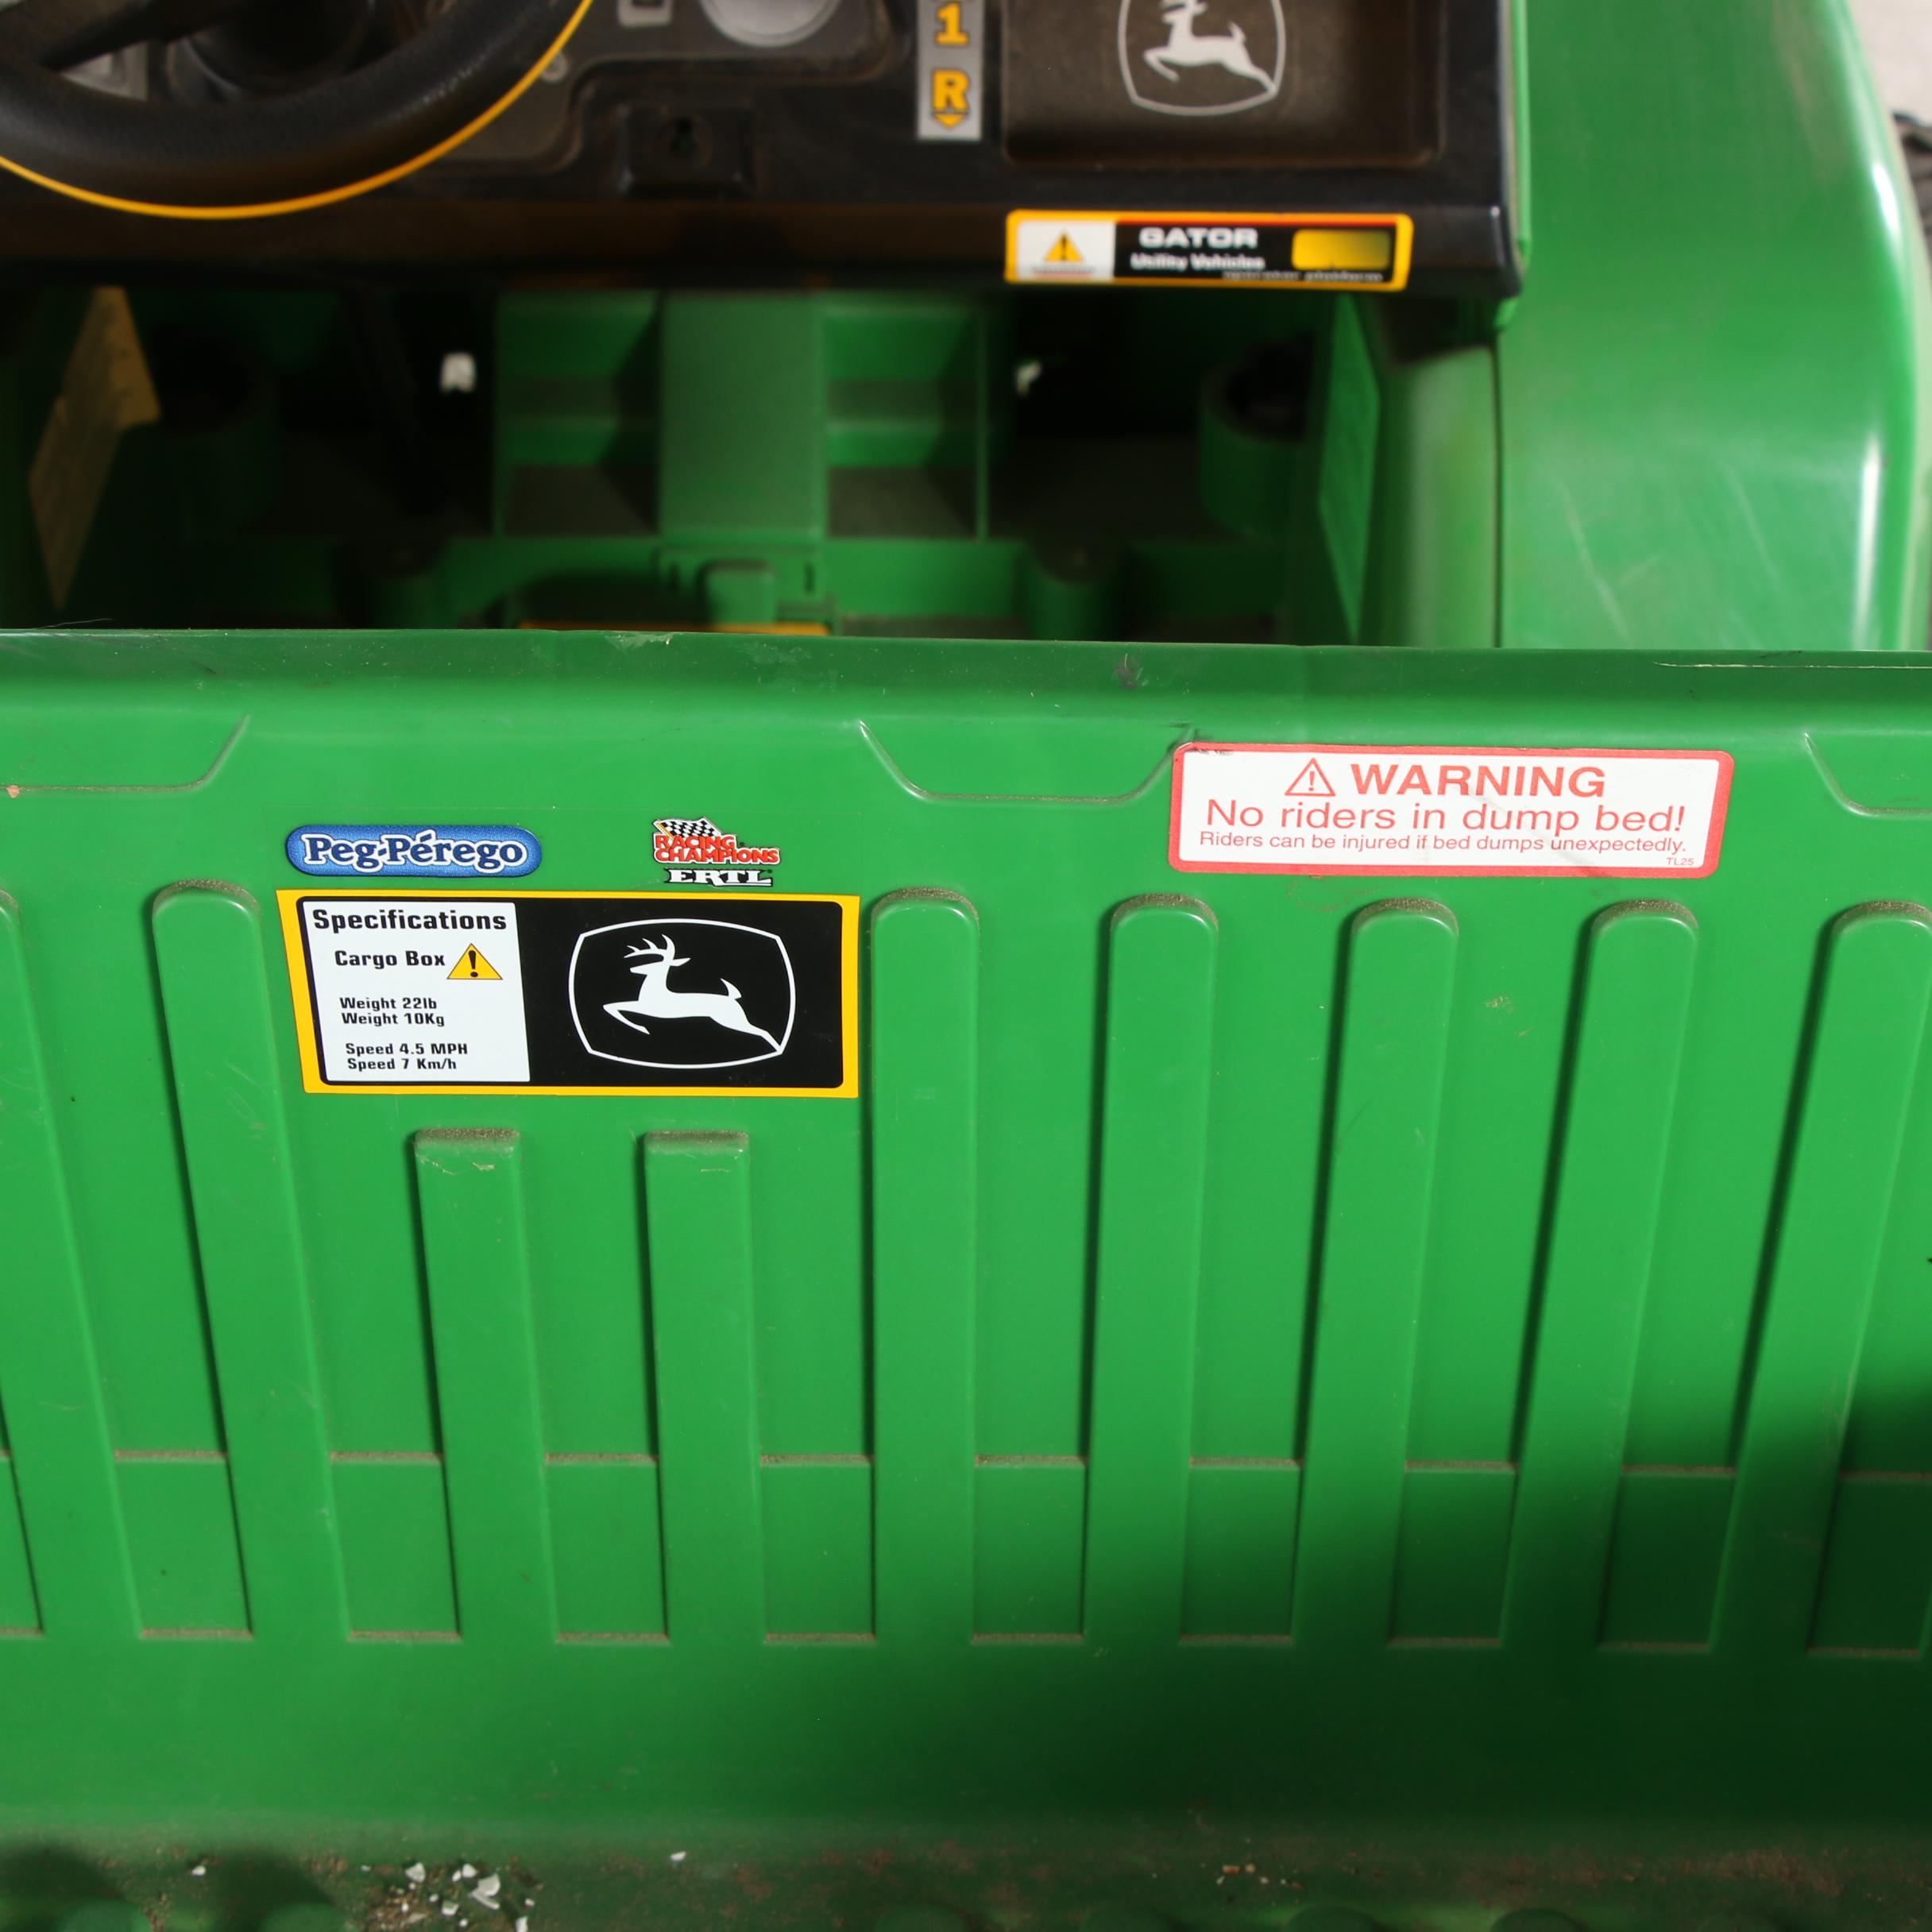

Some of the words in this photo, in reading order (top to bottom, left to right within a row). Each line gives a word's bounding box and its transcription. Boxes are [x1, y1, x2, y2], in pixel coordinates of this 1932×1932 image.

[936, 2, 970, 45] 1
[933, 69, 970, 110] R
[1138, 227, 1258, 249] GATOR
[1130, 253, 1188, 271] Utility
[1190, 253, 1265, 271] Vehicles
[1350, 763, 1605, 798] WARNING
[1207, 799, 1263, 827] No
[1281, 802, 1396, 829] riders
[1412, 803, 1446, 829] in
[1463, 803, 1579, 837] dump
[1595, 805, 1685, 832] bed!
[302, 831, 526, 871] Peg-Pérego
[655, 834, 736, 849] RACING
[1200, 831, 1263, 847] Riders
[1269, 835, 1305, 848] can
[1312, 833, 1336, 848] be
[1343, 834, 1409, 852] injured
[1416, 835, 1428, 850] if
[1433, 835, 1470, 851] bed
[1476, 836, 1544, 853] dumps
[1551, 837, 1687, 856] unexpectedly.
[655, 848, 779, 864] CHAMPIONS
[1666, 857, 1694, 866] TL25
[668, 868, 772, 887] ERTL
[312, 909, 507, 933] Specifications
[334, 950, 398, 969] Cargo
[405, 951, 446, 966] Box
[339, 997, 396, 1011] Weight
[402, 997, 437, 1009] 22lb
[342, 1012, 398, 1026] Weight
[404, 1013, 445, 1026] 10Kg
[346, 1043, 393, 1057] Speed
[400, 1043, 424, 1055] 4.5
[431, 1043, 468, 1054] MPH
[347, 1058, 396, 1072] Speed
[401, 1058, 409, 1069] 7
[417, 1058, 457, 1069] Km/h
